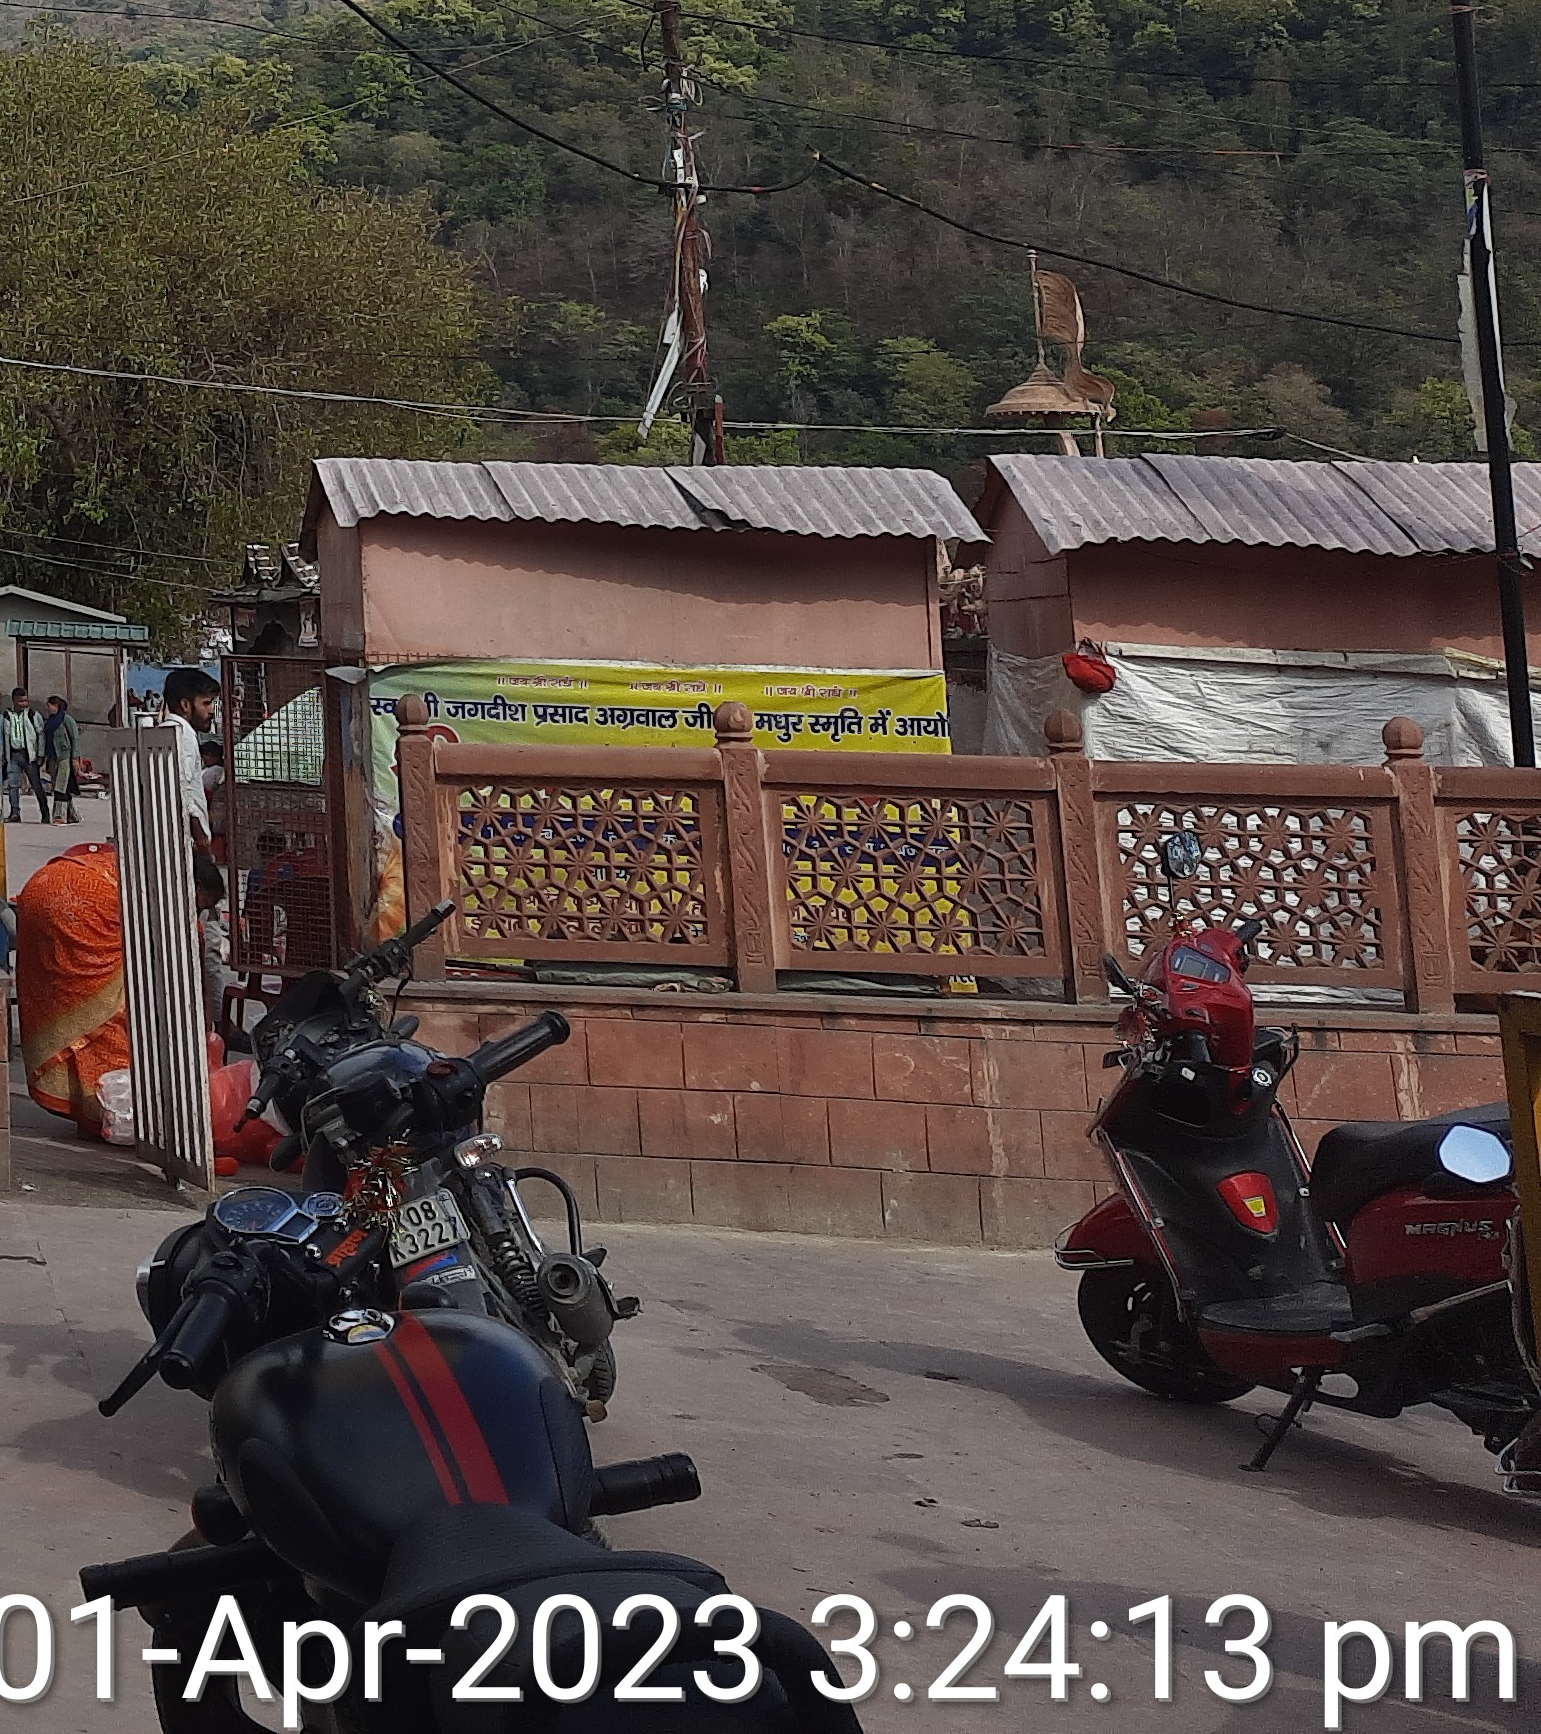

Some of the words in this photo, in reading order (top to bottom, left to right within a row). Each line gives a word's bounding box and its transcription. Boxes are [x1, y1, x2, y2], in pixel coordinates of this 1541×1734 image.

[445, 692, 527, 722] जगदीश
[533, 704, 589, 726] प्रसाद
[594, 707, 678, 729] अग्रवाल
[755, 711, 804, 742] मधुर
[808, 707, 863, 742] स्मृति
[869, 710, 891, 735] में
